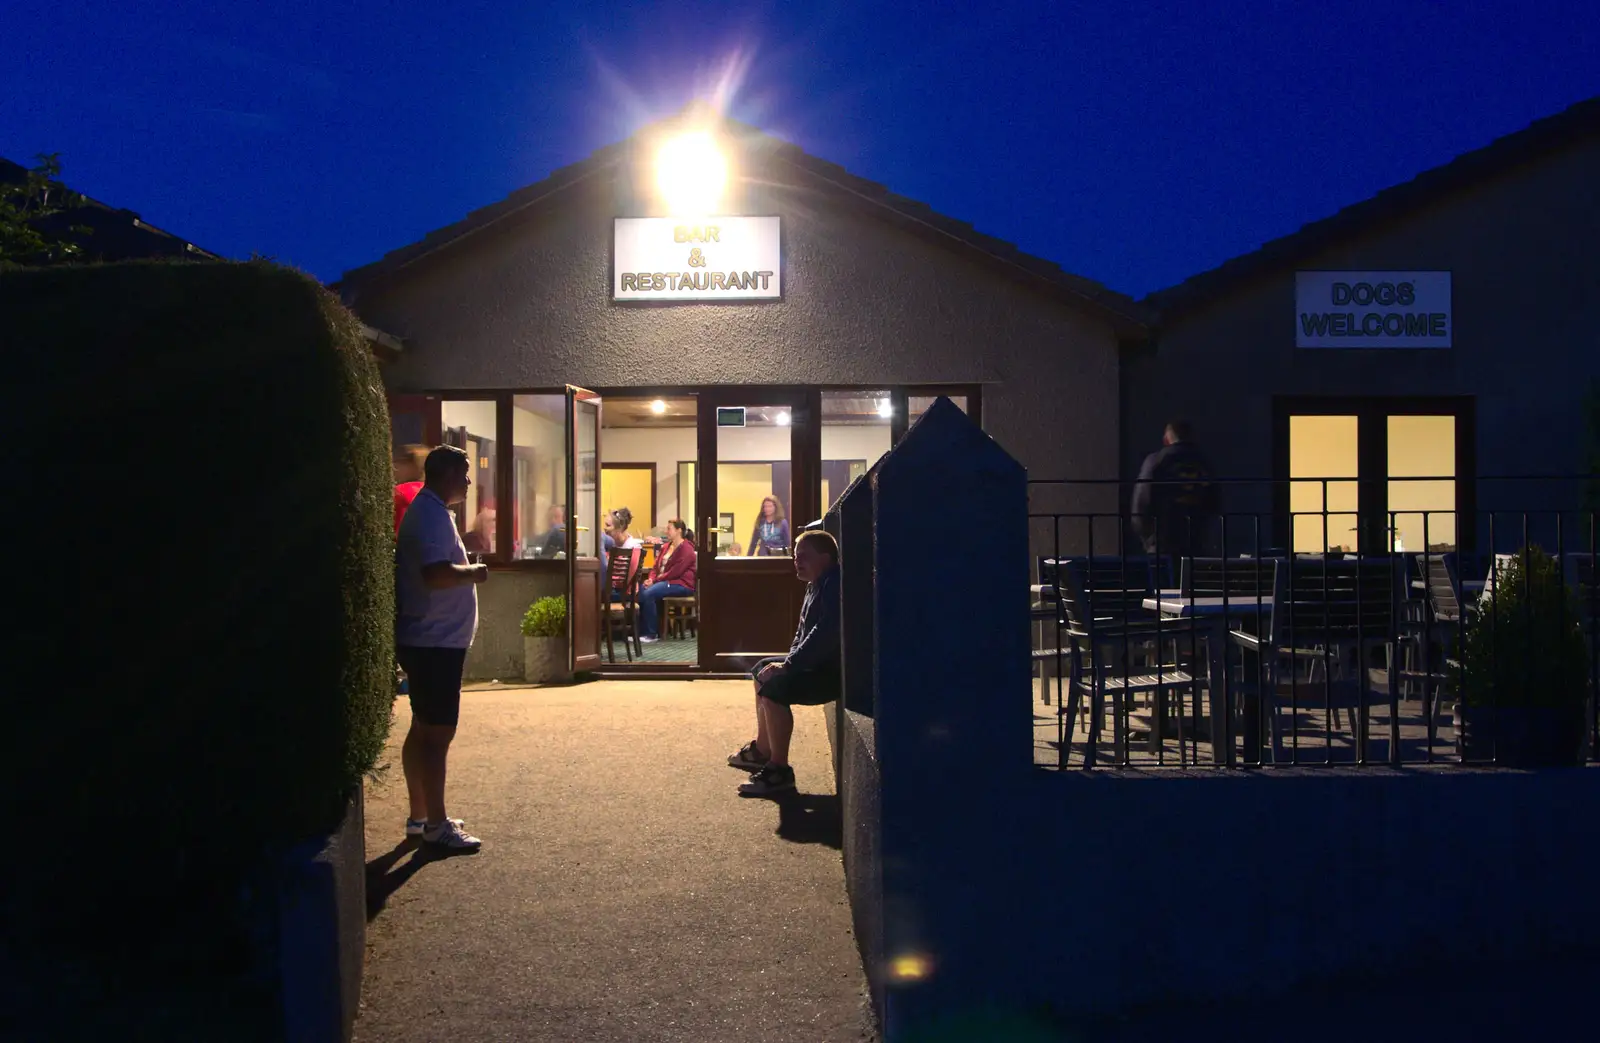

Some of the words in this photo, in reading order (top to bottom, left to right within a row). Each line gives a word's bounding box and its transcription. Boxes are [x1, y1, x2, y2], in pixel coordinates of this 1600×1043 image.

[673, 226, 720, 243] BAR
[688, 248, 706, 267] &
[621, 271, 773, 291] RESTAURANT
[1332, 282, 1415, 305] DOGS
[1301, 313, 1446, 337] WELCOME
